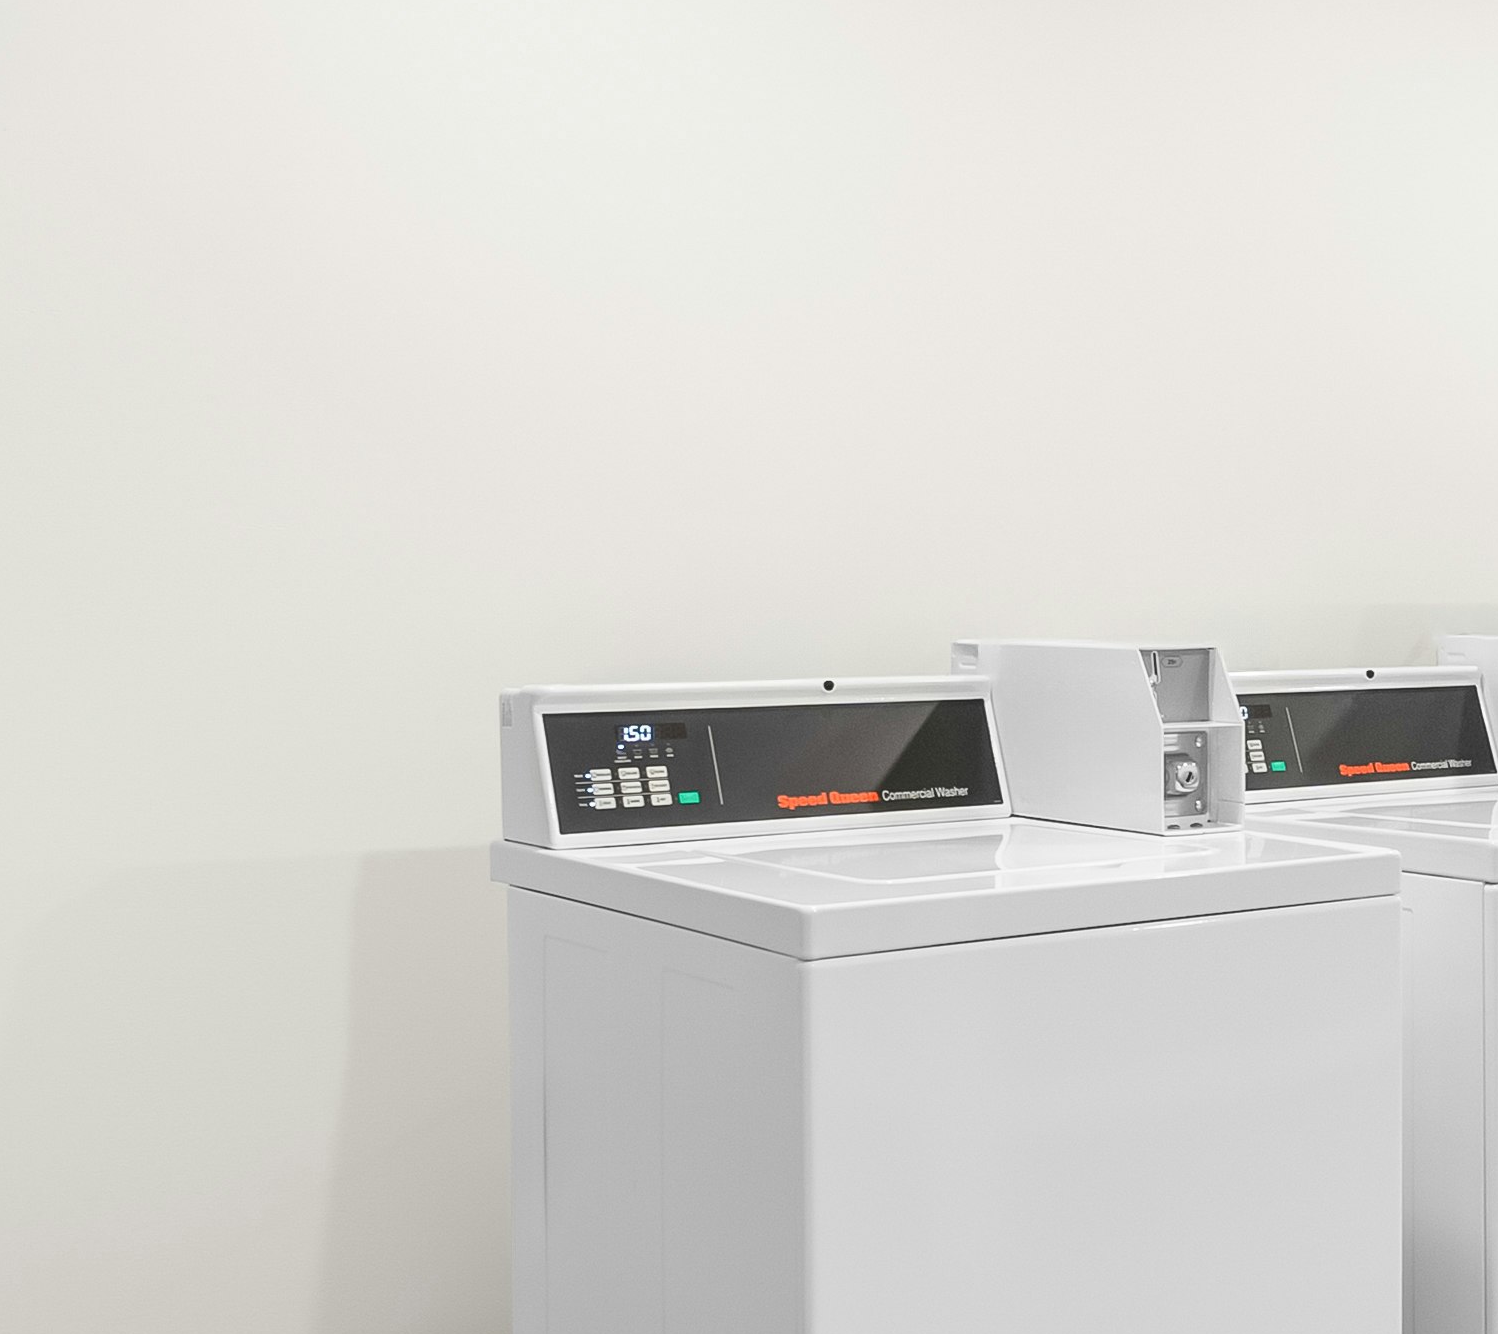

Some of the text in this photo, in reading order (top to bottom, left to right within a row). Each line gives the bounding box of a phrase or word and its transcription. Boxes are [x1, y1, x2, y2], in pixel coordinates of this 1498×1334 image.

[777, 786, 969, 810] Speed Queen Commercial Washer
